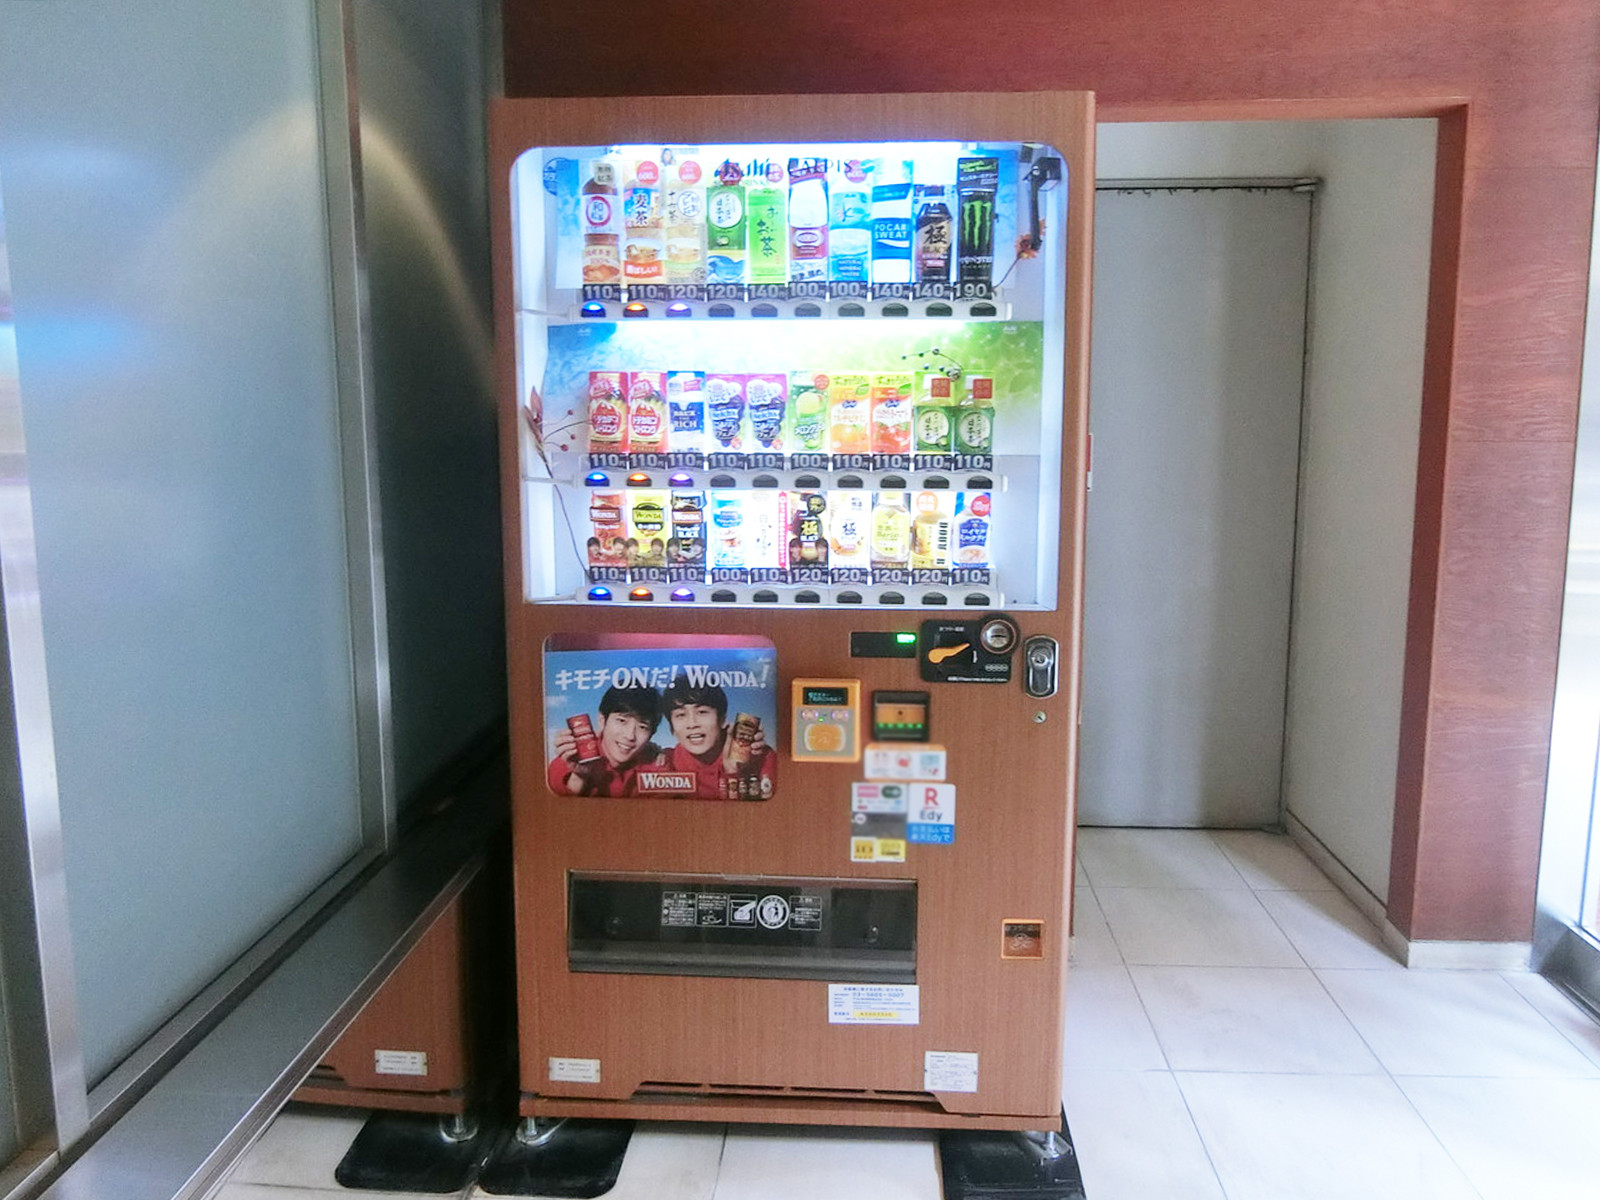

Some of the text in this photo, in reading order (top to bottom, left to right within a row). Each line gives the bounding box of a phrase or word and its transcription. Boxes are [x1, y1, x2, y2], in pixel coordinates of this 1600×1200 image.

[874, 232, 907, 240] SWEAT
[683, 665, 770, 690] WONDA!
[640, 773, 692, 789] WONDA
[925, 787, 939, 806] R
[919, 810, 943, 822] Edy
